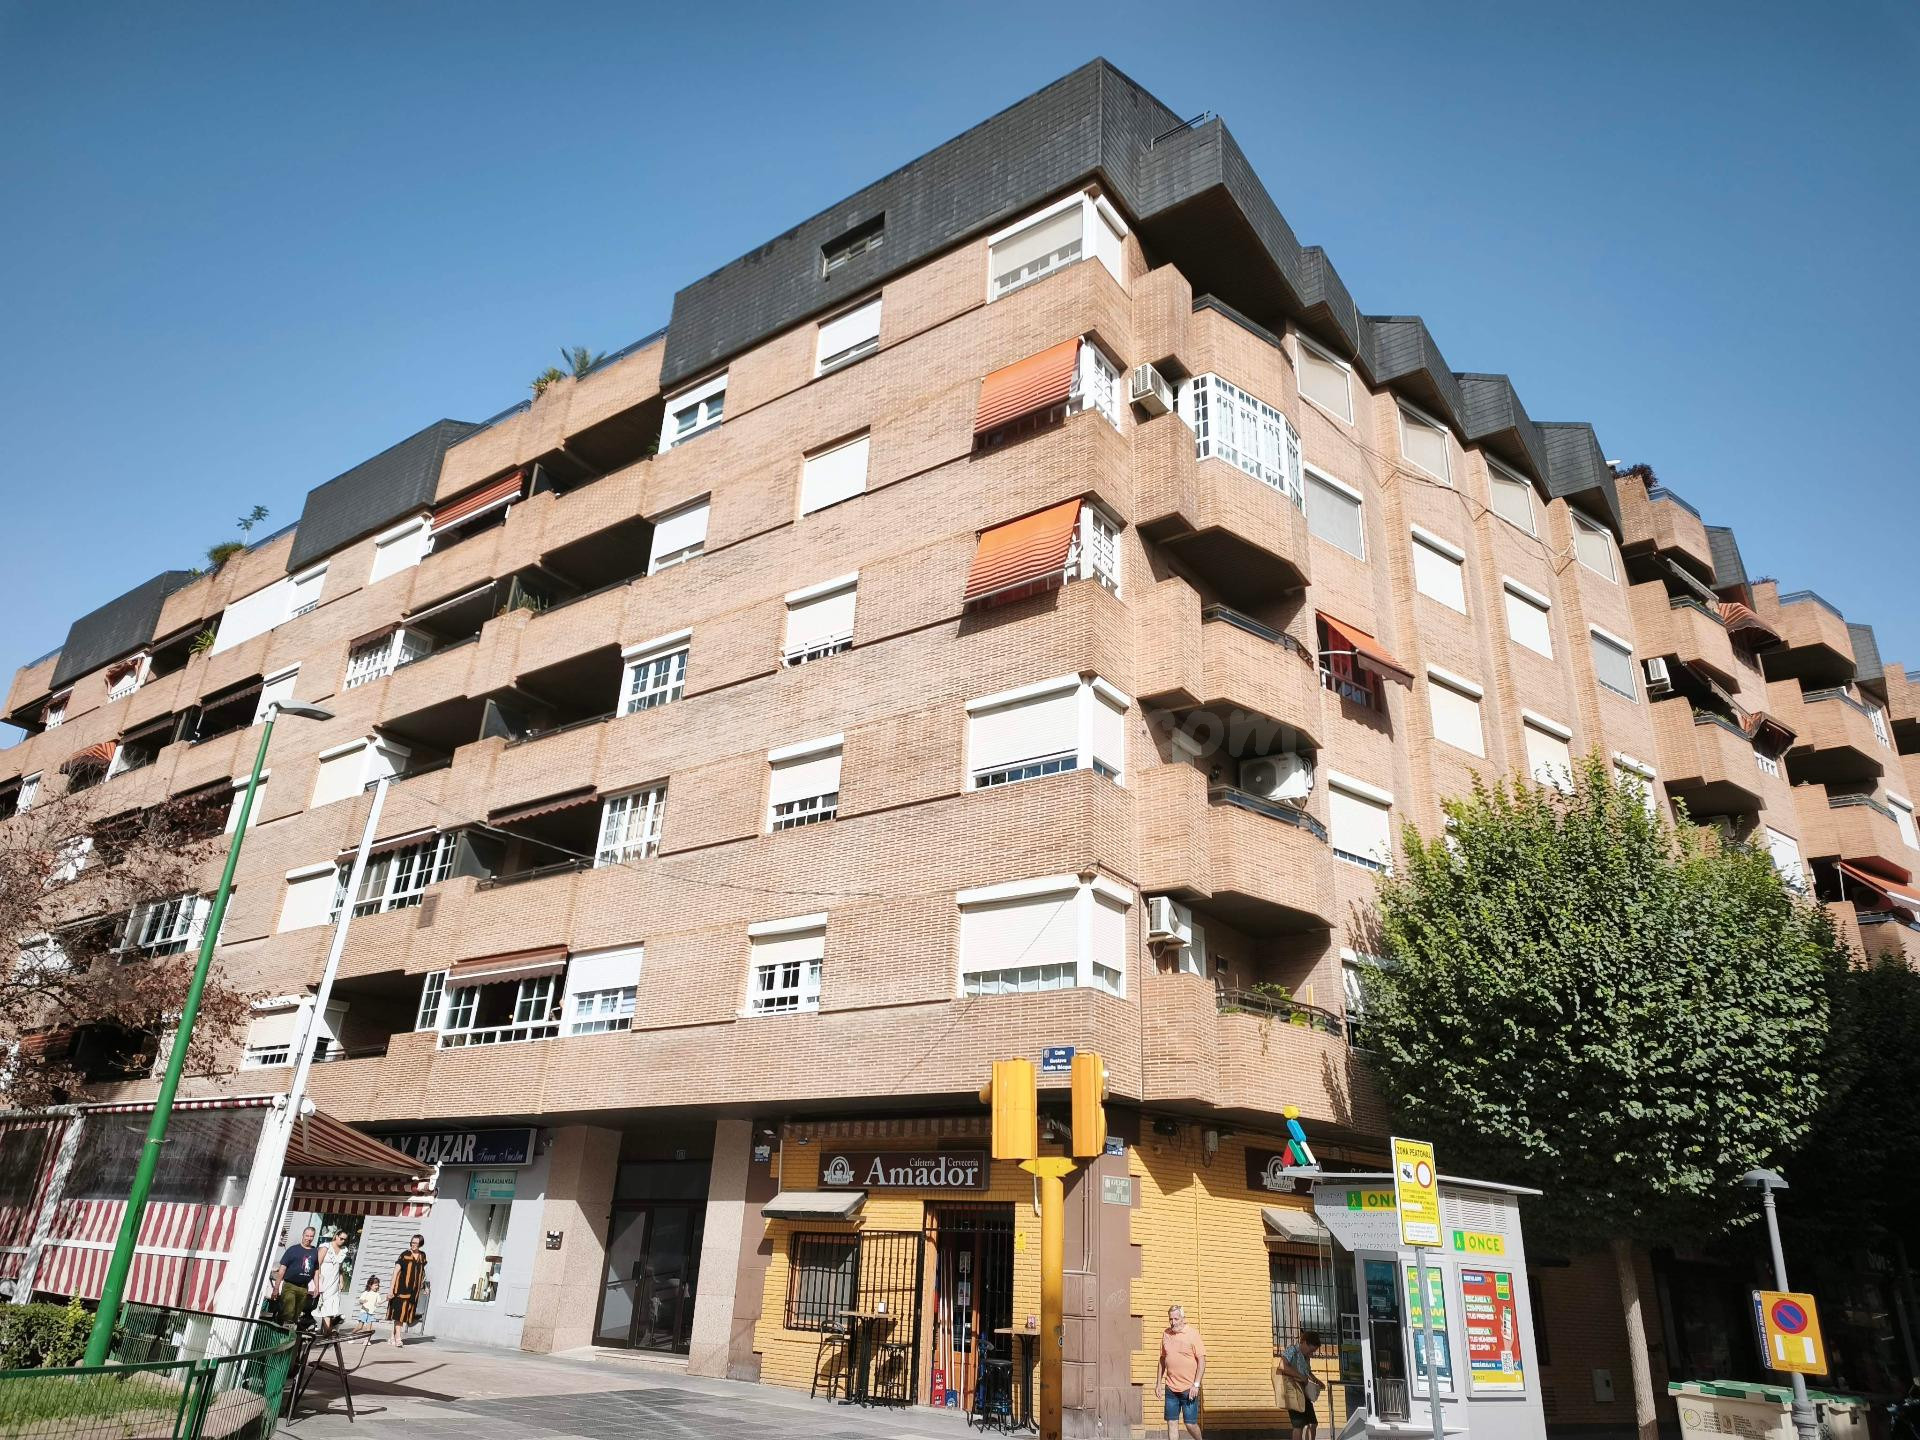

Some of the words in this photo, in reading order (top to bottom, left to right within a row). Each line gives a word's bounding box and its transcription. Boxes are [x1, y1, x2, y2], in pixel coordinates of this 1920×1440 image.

[416, 1134, 477, 1163] BAZAR
[1396, 1146, 1409, 1155] ZONA
[1409, 1147, 1432, 1159] PEATONAL
[863, 1156, 979, 1186] Amador
[1468, 1235, 1500, 1252] ONCE
